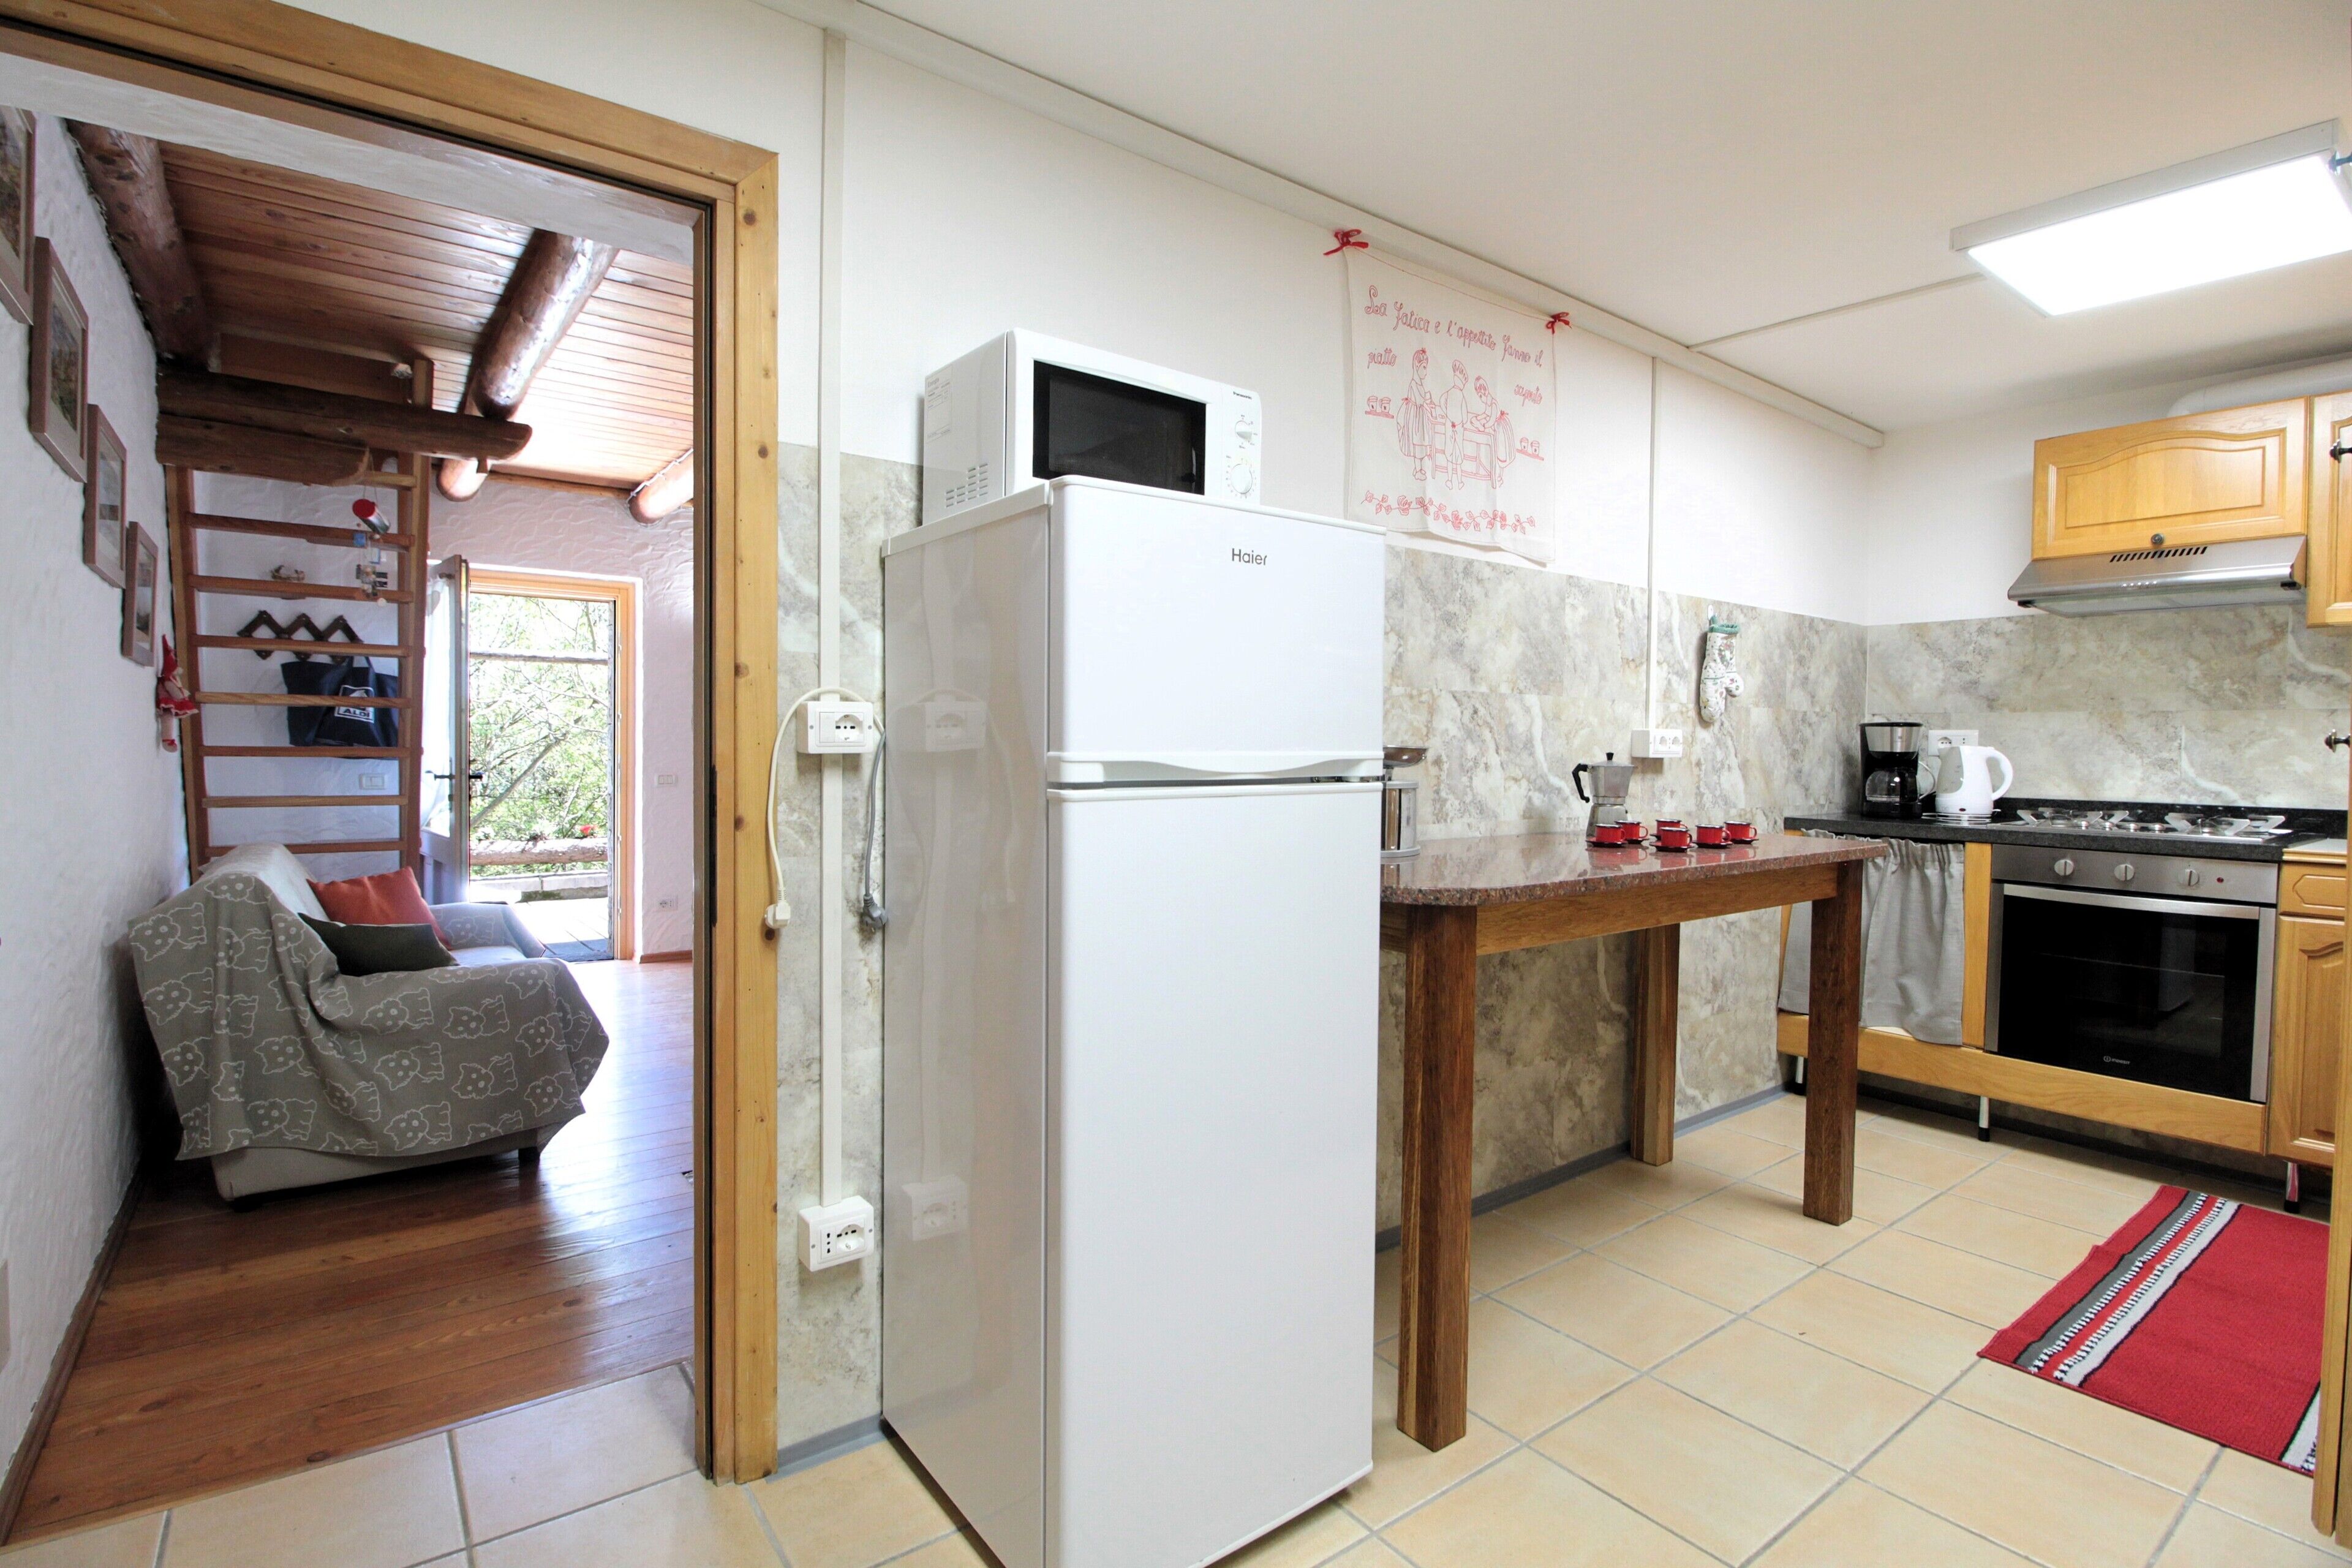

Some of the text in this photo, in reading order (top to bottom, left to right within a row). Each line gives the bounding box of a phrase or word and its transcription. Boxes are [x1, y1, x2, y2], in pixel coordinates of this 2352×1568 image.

[1364, 285, 1387, 317] La
[1434, 321, 1441, 334] e
[1535, 349, 1544, 368] il
[1367, 347, 1396, 369] piatto
[1232, 391, 1253, 400] Panasonic
[1232, 548, 1267, 565] Haier
[343, 708, 370, 717] ALDI
